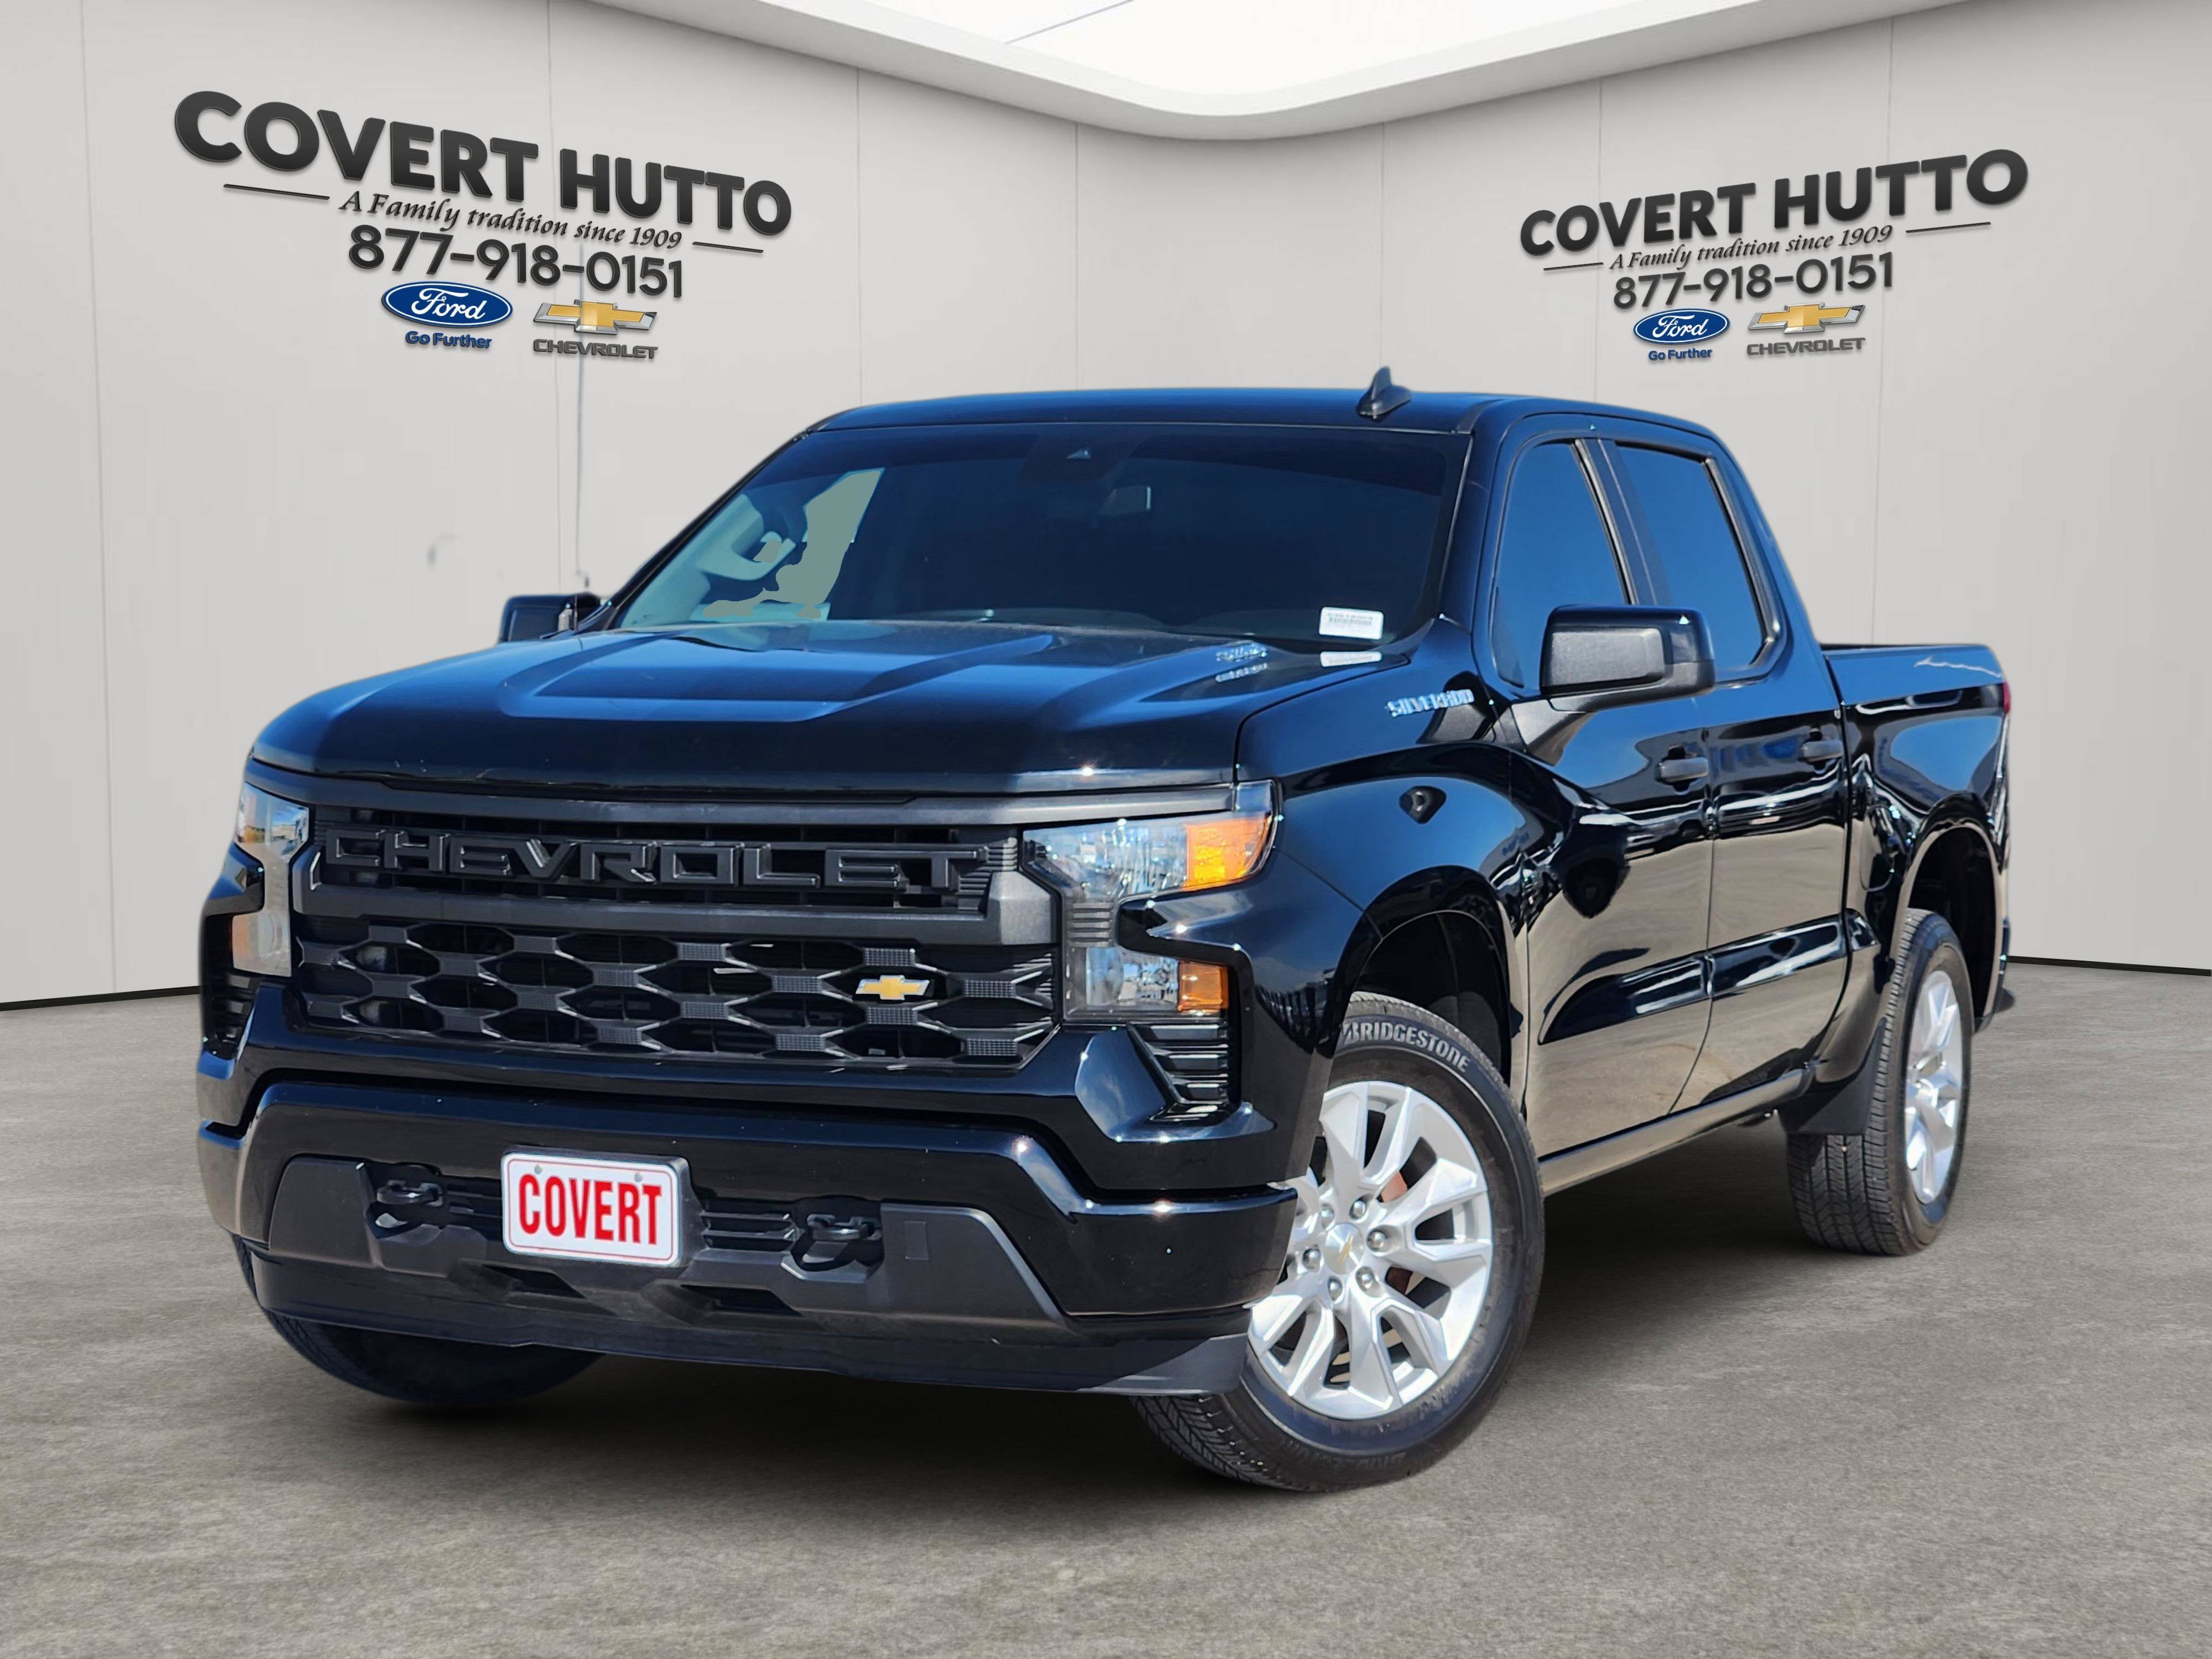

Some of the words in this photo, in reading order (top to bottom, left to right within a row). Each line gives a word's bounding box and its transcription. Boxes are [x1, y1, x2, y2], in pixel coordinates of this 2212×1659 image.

[174, 91, 539, 204] COVERT
[560, 148, 791, 237] HUTTO
[338, 190, 362, 212] A
[367, 193, 460, 232] Family
[467, 207, 568, 236] tradition
[573, 223, 626, 245] since
[629, 227, 682, 249] 1909
[1520, 182, 1756, 257] COVERT
[1774, 149, 2028, 230] HUTTO
[348, 225, 682, 299] 877-918-0151
[1609, 253, 1625, 270] A
[1627, 244, 1692, 270] Family
[1697, 238, 1780, 261] tradition
[1785, 235, 1834, 252] since
[1838, 225, 1893, 247] 1909
[411, 288, 488, 320] Ford
[1613, 251, 1893, 310] 877-918-0151
[405, 331, 431, 345] Go
[432, 332, 493, 349] Further
[533, 338, 658, 359] CHEVROLET
[1652, 315, 1709, 338] Ford
[1746, 337, 1866, 356] CHEVROLET
[1648, 350, 1666, 361] Go
[1667, 347, 1713, 360] Further
[326, 828, 988, 889] CHEVROLET
[1342, 1021, 1471, 1073] BRIDGESTONE
[518, 1173, 662, 1245] COVERT
